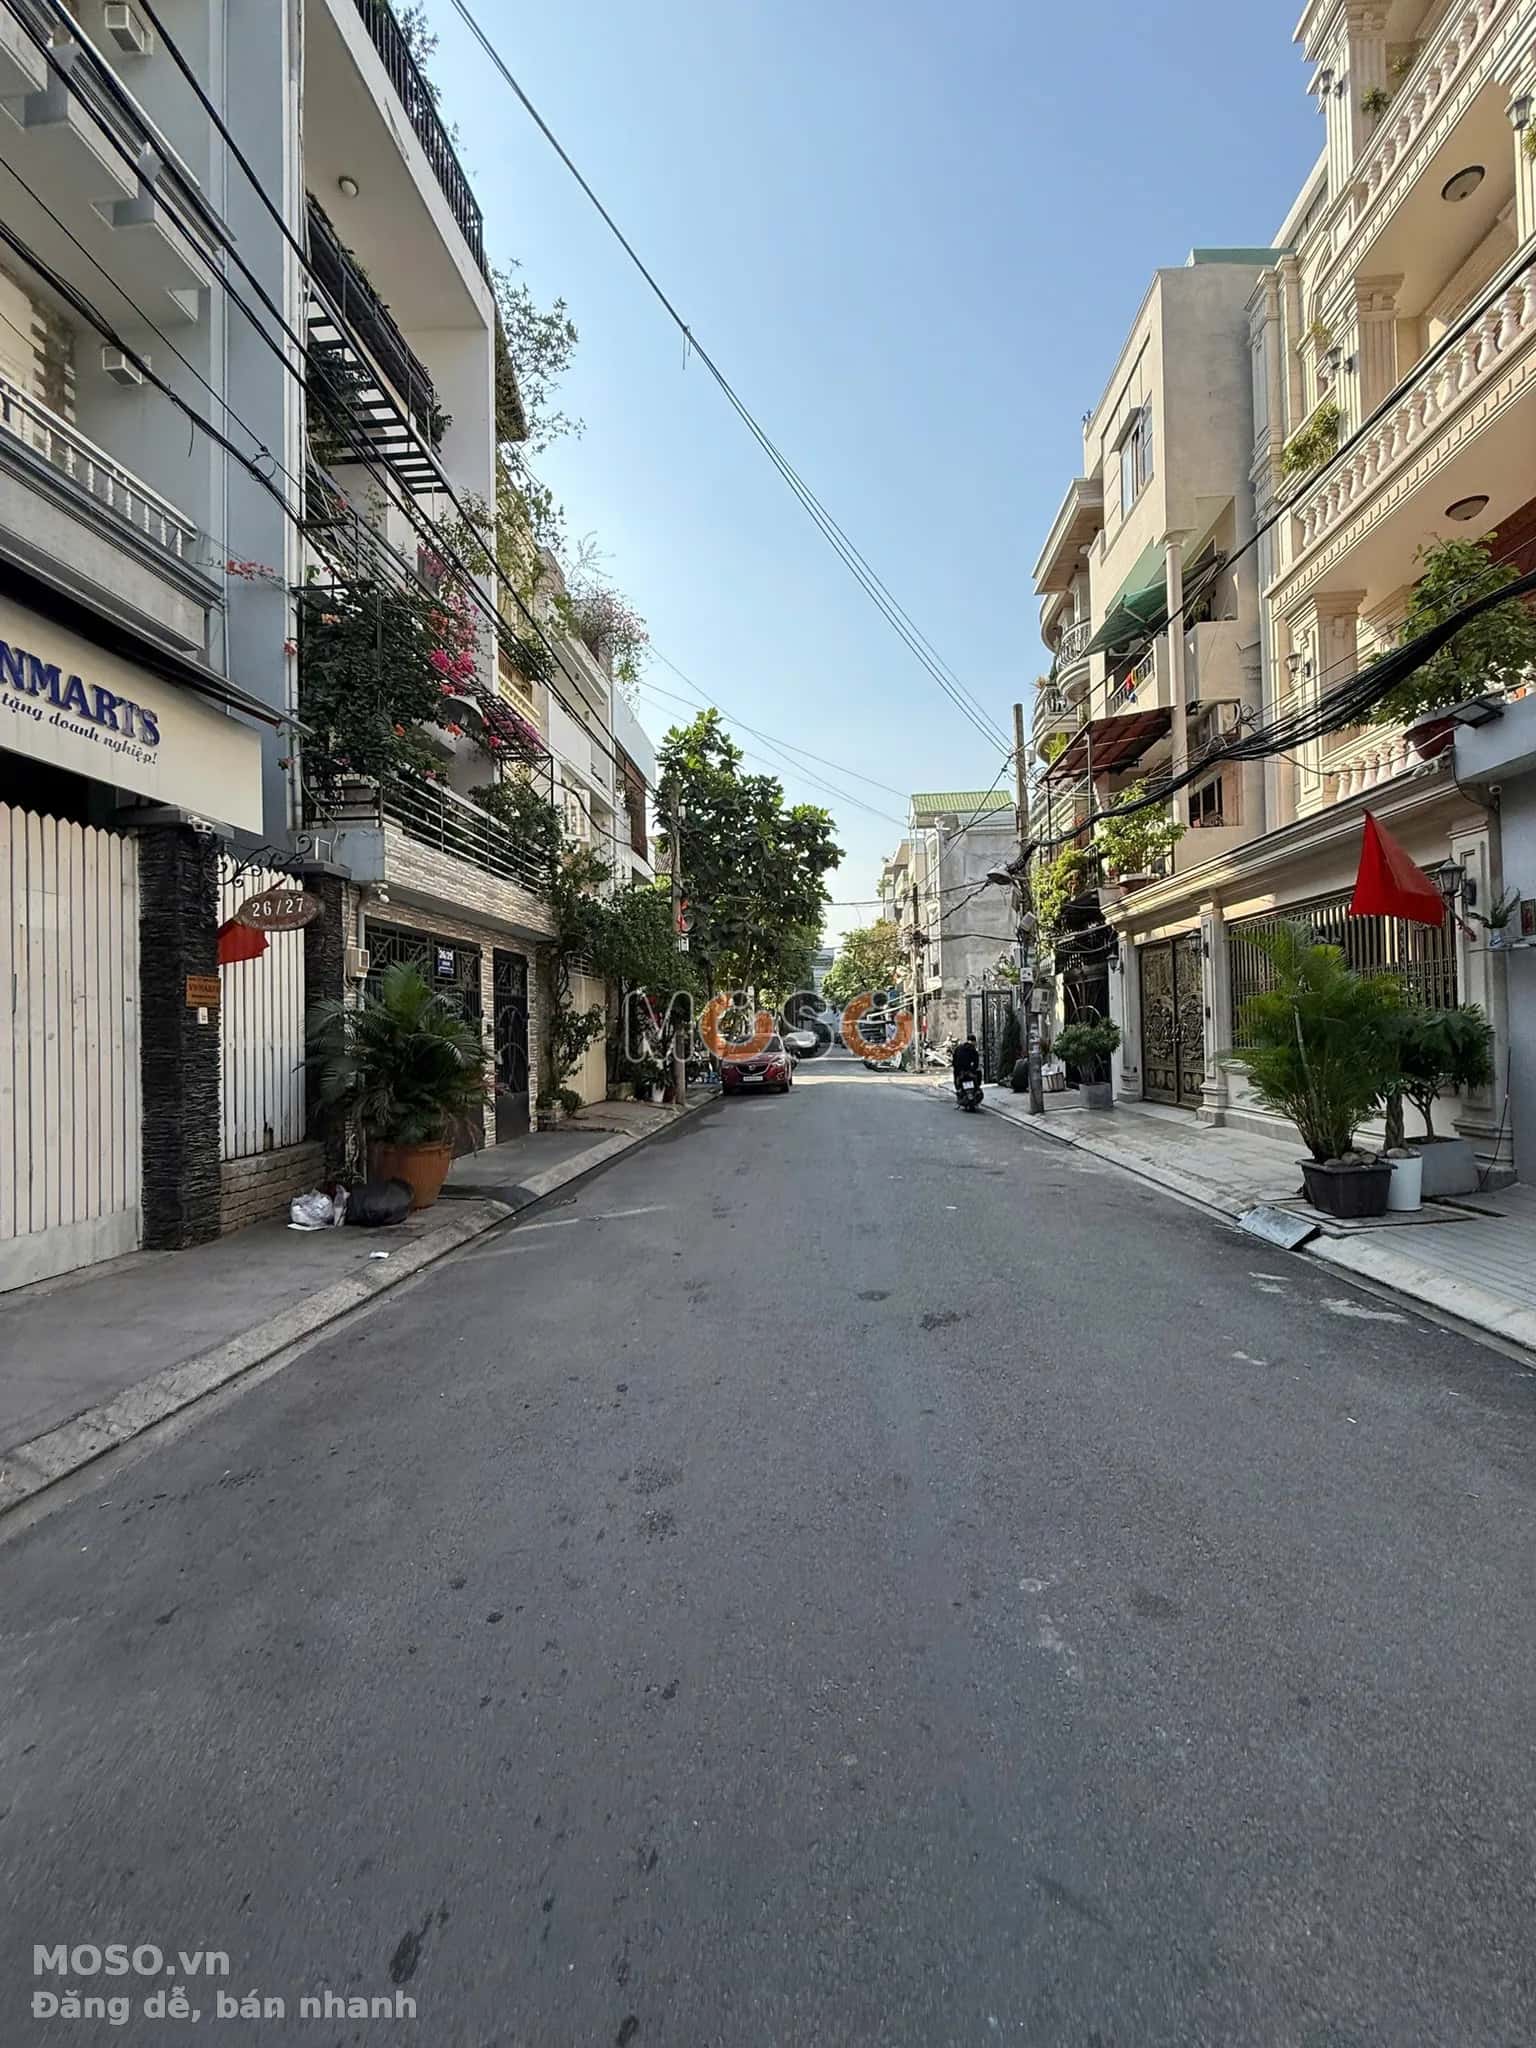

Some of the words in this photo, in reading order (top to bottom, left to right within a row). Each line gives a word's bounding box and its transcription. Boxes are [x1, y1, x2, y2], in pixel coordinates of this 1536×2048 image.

[49, 712, 99, 742] doanh
[103, 737, 157, 764] nghiệp!
[252, 898, 304, 917] 26/27
